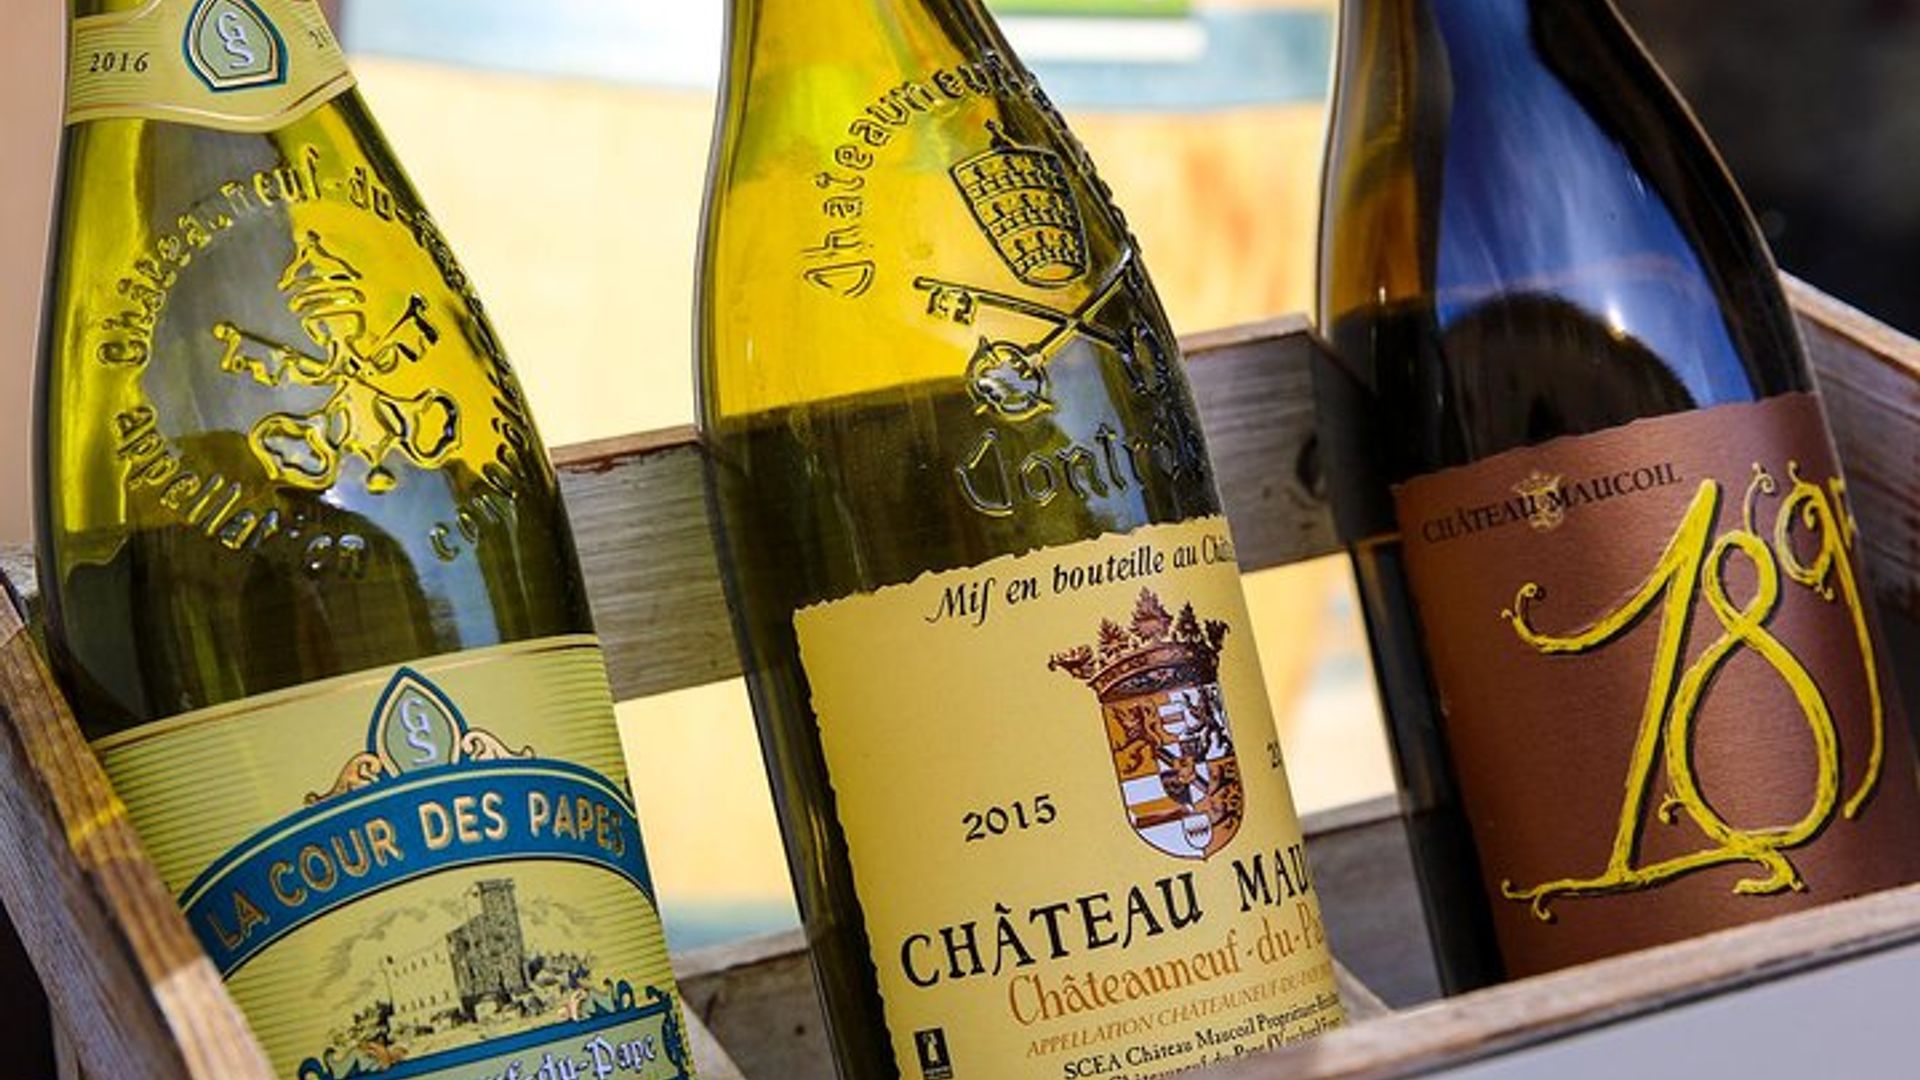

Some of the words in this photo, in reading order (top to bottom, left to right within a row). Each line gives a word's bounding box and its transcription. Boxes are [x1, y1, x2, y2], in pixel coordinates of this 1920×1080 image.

[89, 52, 149, 73] 2016
[1546, 462, 1683, 513] MAUCOIL
[1005, 575, 1041, 605] en
[1053, 545, 1165, 595] bouteille
[1173, 545, 1197, 569] au
[961, 793, 1059, 844] 2015
[207, 892, 271, 951] LA
[268, 817, 405, 908] COUR
[418, 791, 508, 850] DES
[528, 791, 625, 857] PAPES
[1026, 1012, 1153, 1059] APPELLATION
[1063, 1052, 1122, 1080] SCEA
[1126, 1041, 1193, 1067] Château
